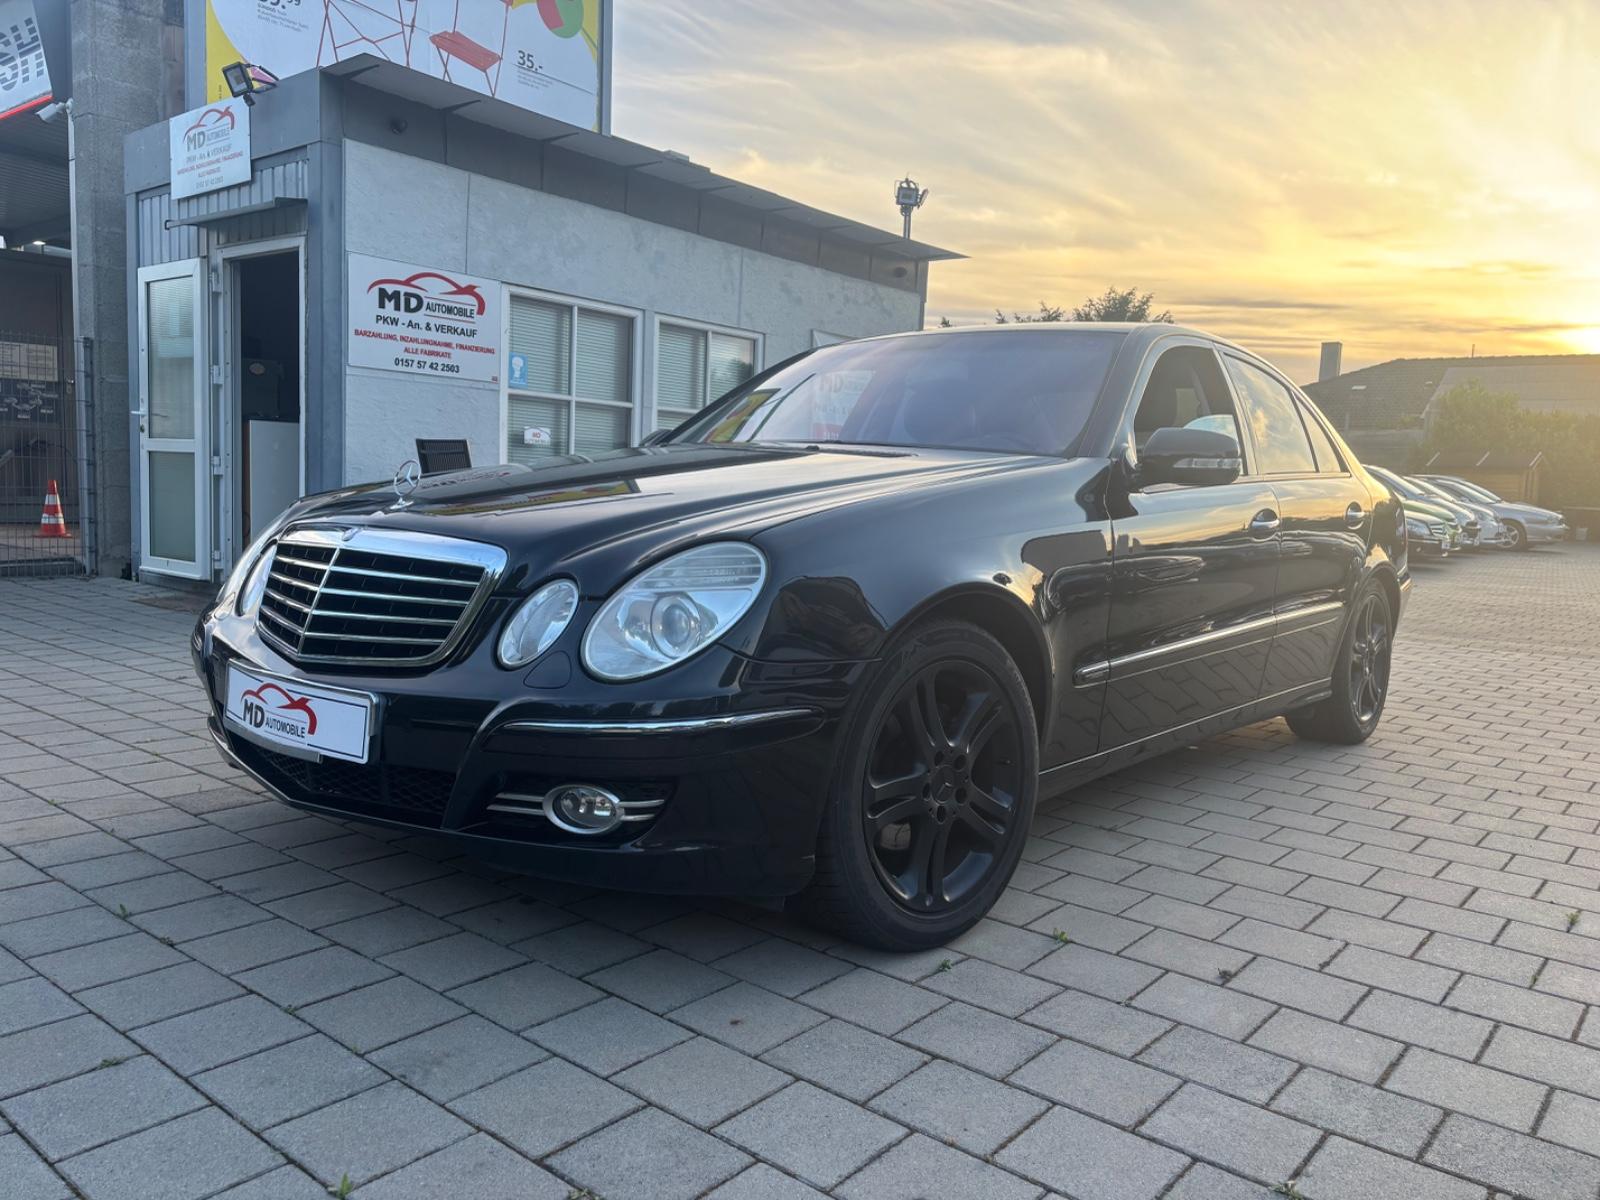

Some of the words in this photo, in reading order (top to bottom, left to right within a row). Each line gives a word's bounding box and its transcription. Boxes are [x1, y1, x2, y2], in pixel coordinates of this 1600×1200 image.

[518, 50, 543, 71] 35.-
[187, 131, 205, 152] MD
[378, 287, 424, 313] MD
[426, 301, 475, 319] AUTOMOBILE
[376, 314, 399, 327] PKW
[407, 319, 422, 331] An.
[425, 322, 432, 331] &
[434, 324, 477, 338] VERKAUF
[354, 329, 399, 342] BARZAHLUNG,
[455, 343, 495, 355] FINANZIERUNG
[404, 347, 419, 355] ALLE
[420, 349, 452, 359] FABRIKATE
[394, 357, 414, 367] 0157
[417, 360, 427, 369] 57
[429, 362, 439, 371] 42
[441, 363, 460, 373] 2503
[243, 699, 265, 728] MD
[265, 716, 306, 739] AUTOMOBILE
